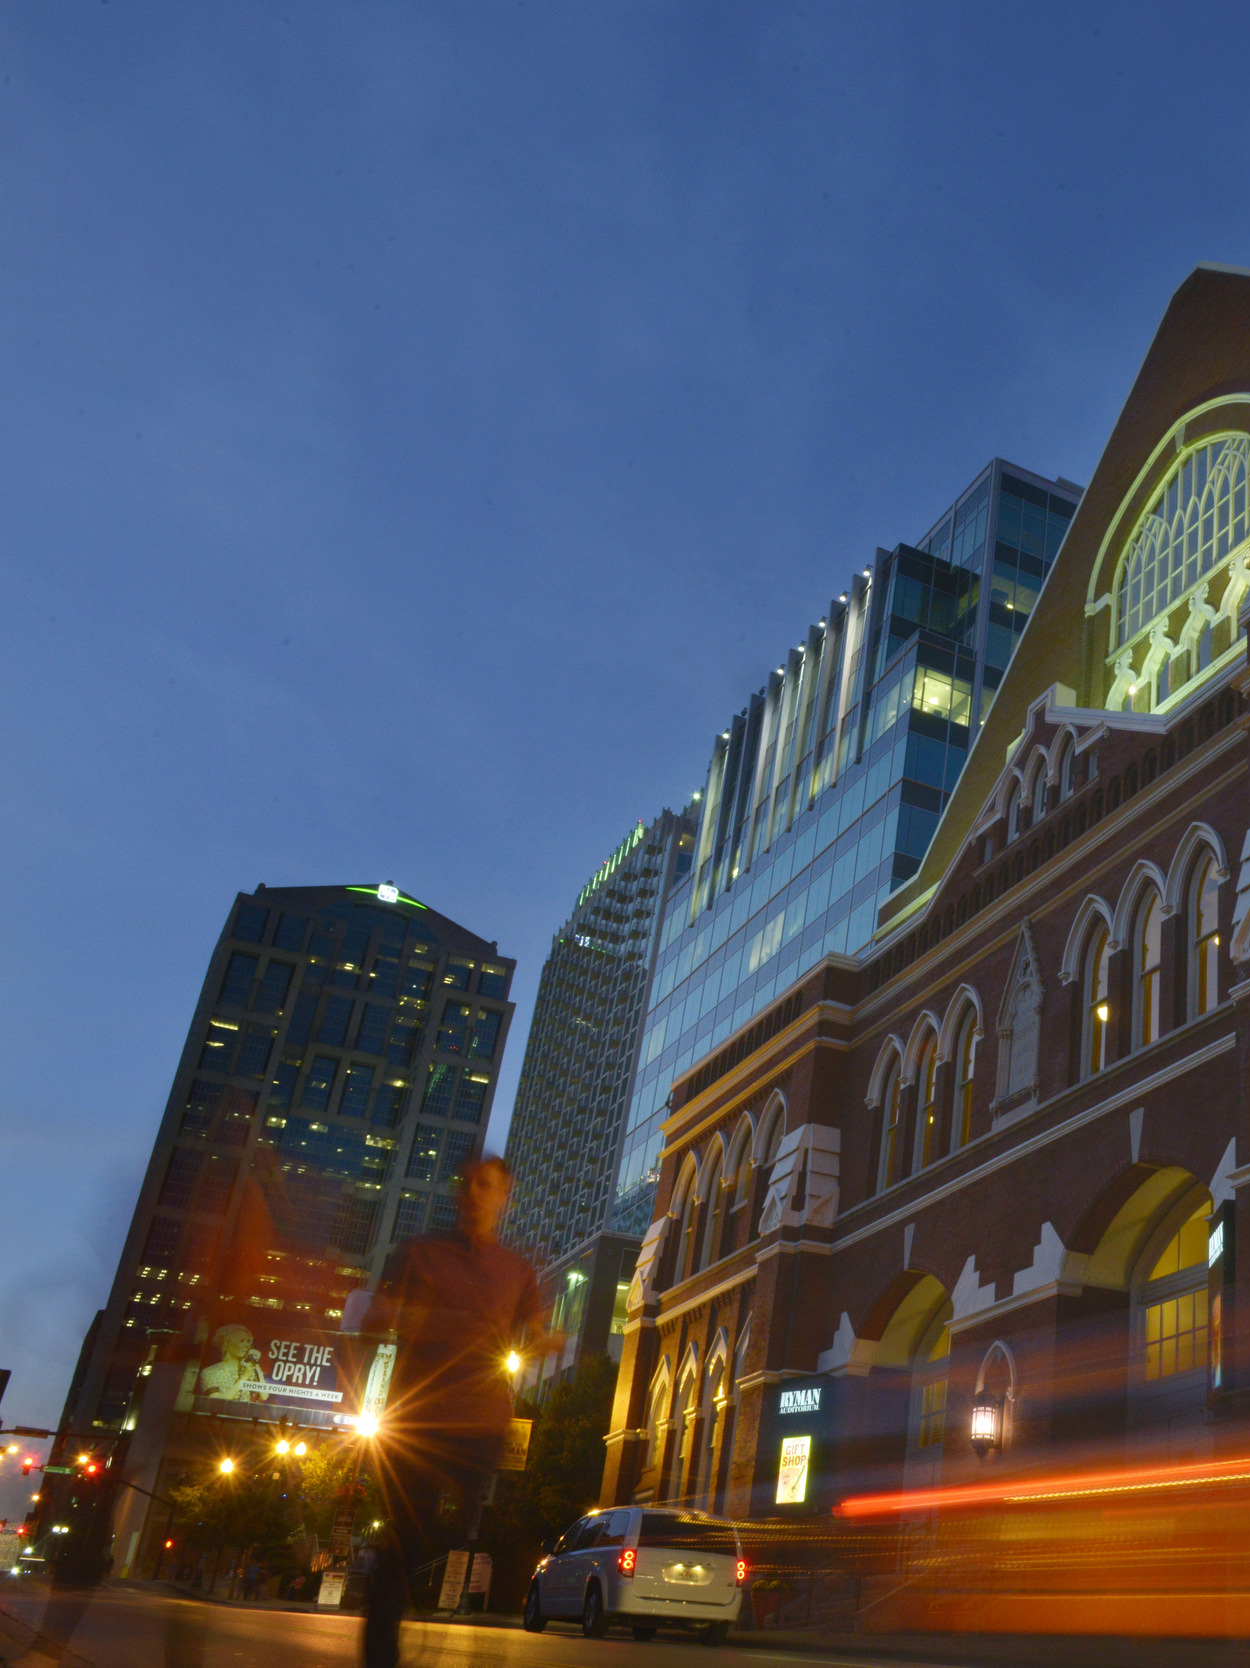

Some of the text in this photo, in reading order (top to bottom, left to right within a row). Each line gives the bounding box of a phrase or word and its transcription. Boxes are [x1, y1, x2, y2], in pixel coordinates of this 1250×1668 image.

[268, 1339, 334, 1366] SEE THE
[272, 1361, 320, 1386] OPRY!
[242, 1382, 267, 1392] SHOWS
[268, 1385, 288, 1394] FOUR
[288, 1387, 313, 1397] NIGHTS
[320, 1392, 340, 1400] WEEK
[779, 1388, 821, 1407] RYMAN
[779, 1404, 820, 1415] AUDITORIUM
[785, 1444, 806, 1455] GIFT
[782, 1455, 806, 1467] SHOP
